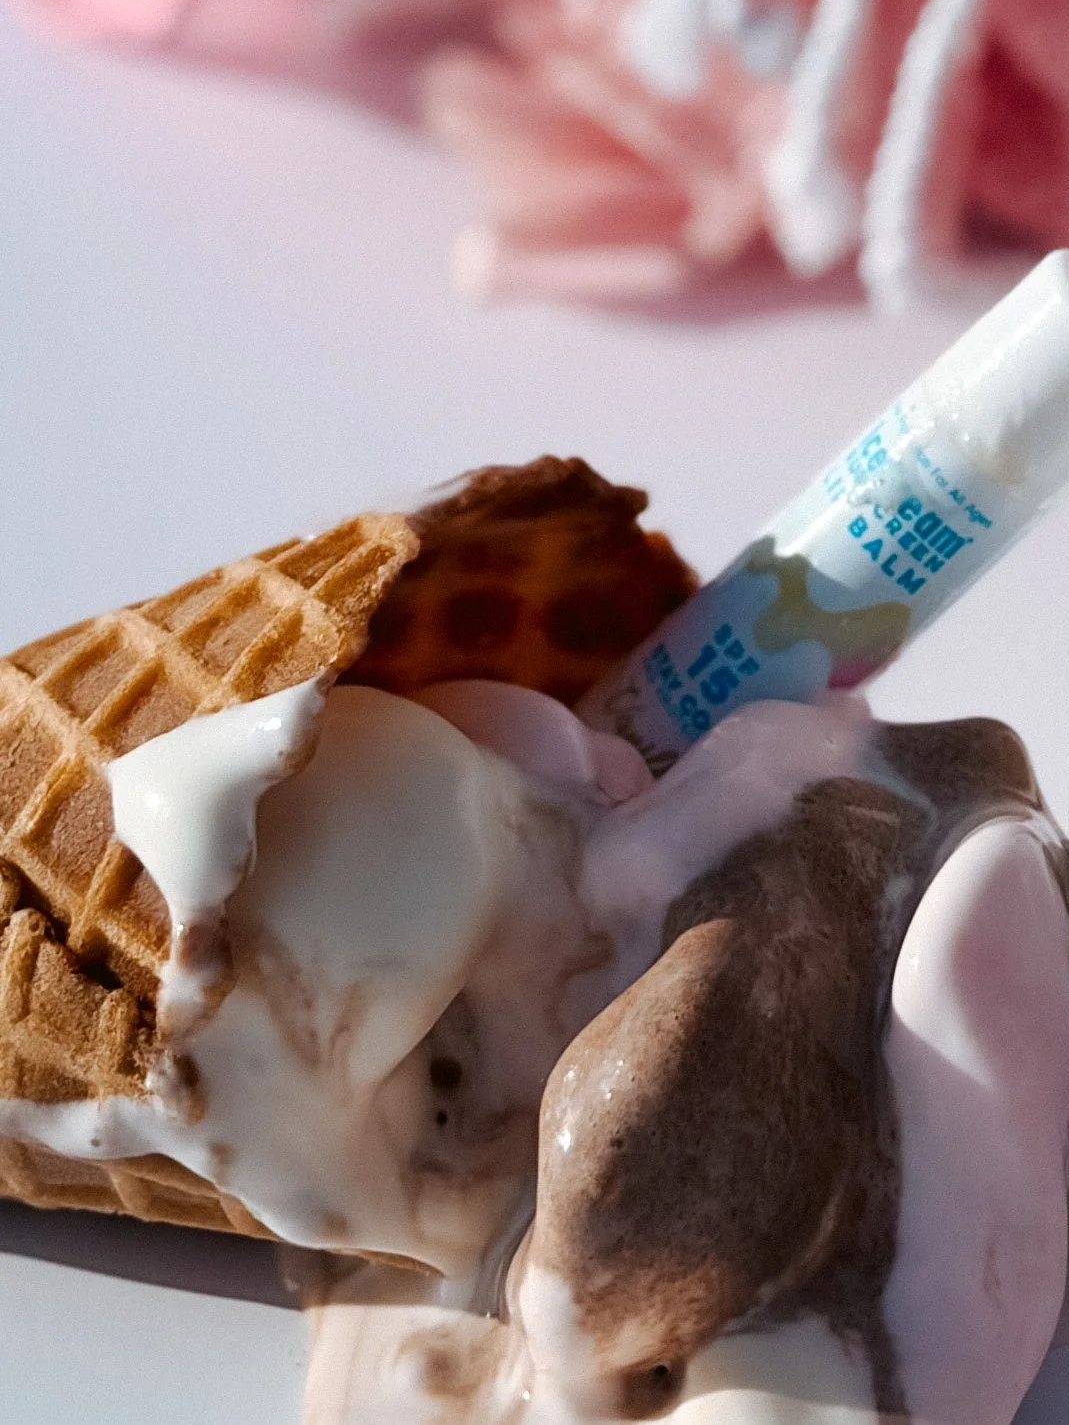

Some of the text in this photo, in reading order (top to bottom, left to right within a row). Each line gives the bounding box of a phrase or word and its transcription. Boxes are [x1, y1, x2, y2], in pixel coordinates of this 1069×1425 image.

[848, 515, 927, 595] BALM
[687, 643, 740, 705] 15
[713, 622, 760, 676] SPF
